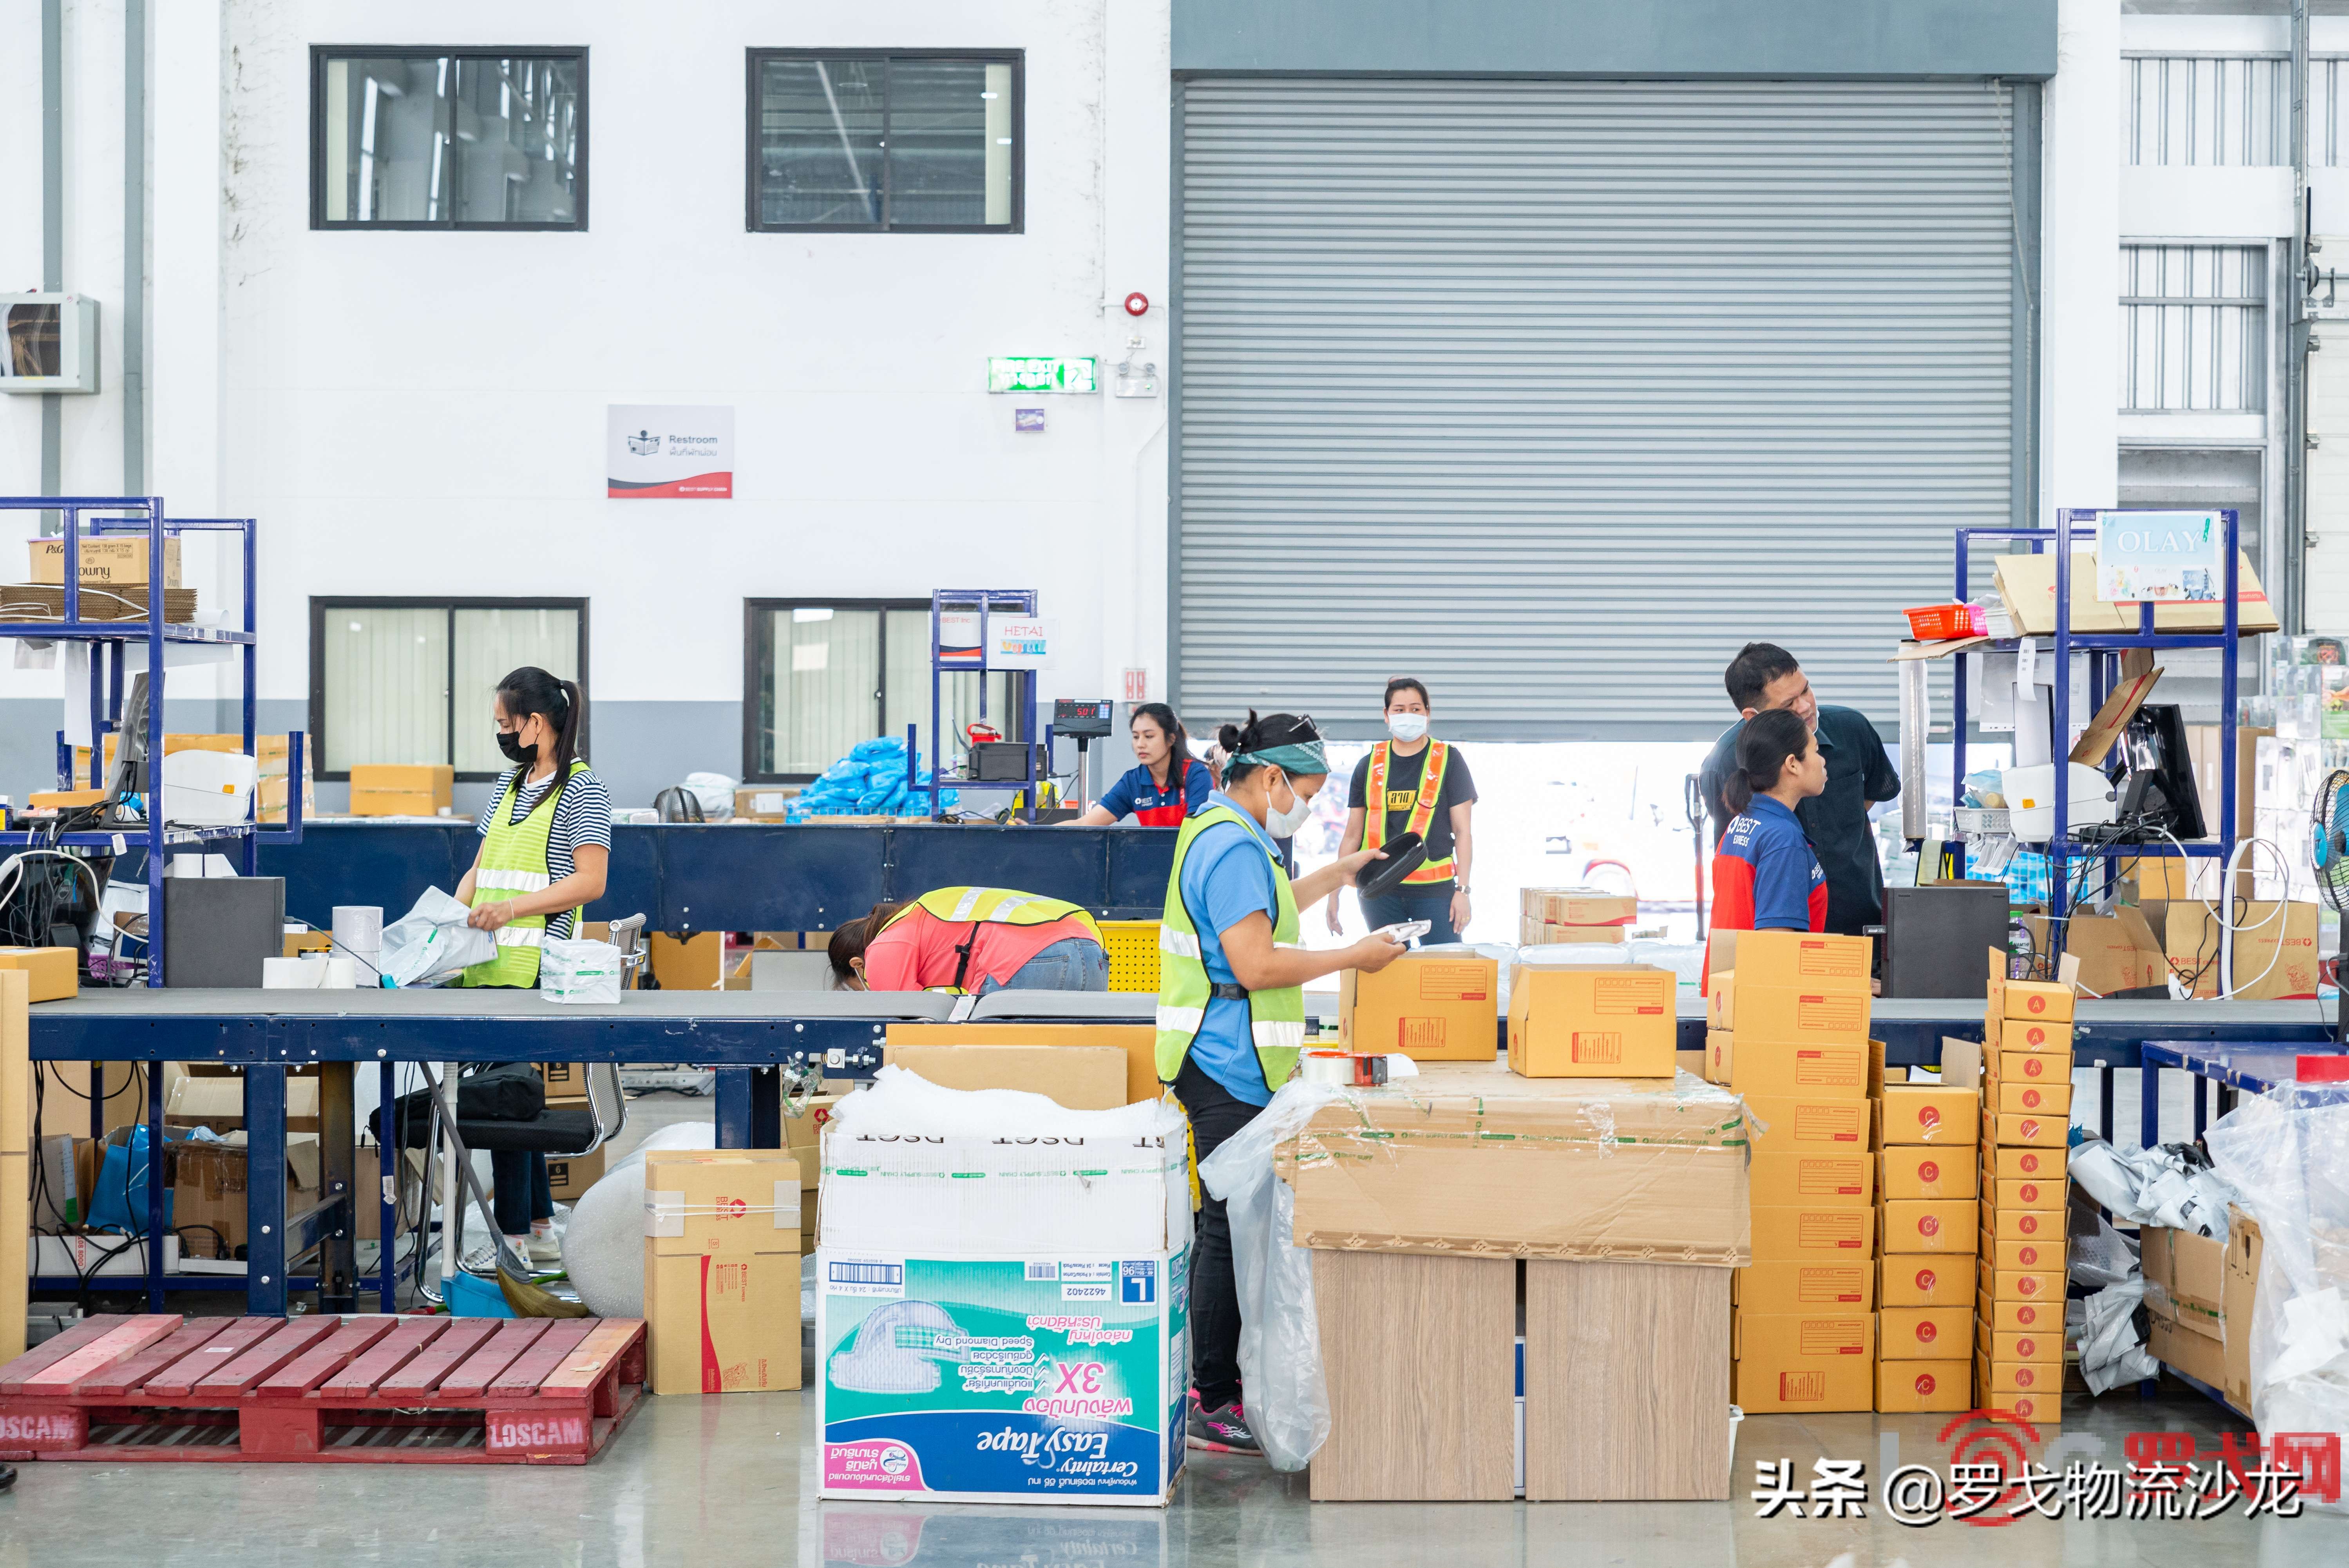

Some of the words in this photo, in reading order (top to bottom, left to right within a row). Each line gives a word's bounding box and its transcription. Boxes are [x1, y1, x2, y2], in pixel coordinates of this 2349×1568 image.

[991, 359, 1025, 373] FIRE
[1027, 359, 1060, 373] EXIT
[998, 373, 1052, 386] ทางออก
[669, 435, 718, 444] Restroom
[670, 446, 717, 457] พื้นที่พักผ่อน
[2117, 530, 2200, 553] OLAY
[45, 544, 64, 554] P&G
[79, 567, 110, 579] owny
[1004, 626, 1043, 637] HETAI
[1736, 817, 1761, 835] BEST
[2032, 1000, 2040, 1010] A
[2031, 1031, 2040, 1042] A
[2029, 1063, 2037, 1073] A
[2027, 1094, 2035, 1104] A
[1925, 1111, 1933, 1122] C
[2025, 1123, 2034, 1134] A
[2025, 1158, 2033, 1168] A
[1924, 1166, 1933, 1177] C
[2025, 1188, 2033, 1199] A
[1924, 1220, 1932, 1232] C
[2024, 1219, 2032, 1230] A
[2024, 1251, 2032, 1261] A
[1123, 1266, 1135, 1275] 96
[1921, 1274, 1930, 1285] C
[1131, 1277, 1146, 1301] L
[2023, 1280, 2030, 1291] A
[1067, 1288, 1106, 1296] 4622402
[2022, 1310, 2030, 1320] A
[1028, 1317, 1101, 1331] ประหยัดกว่า
[1068, 1330, 1131, 1344] กล่องใหญ่
[1922, 1326, 1930, 1338] C
[936, 1335, 952, 1346] Dry
[956, 1338, 998, 1346] Diamond
[1002, 1336, 1033, 1346] Speed
[2022, 1342, 2030, 1353] A
[973, 1350, 1033, 1364] ดูดซึมเร็วด้วย
[1054, 1363, 1104, 1394] 3X
[2021, 1373, 2029, 1383] A
[1921, 1379, 1929, 1390] C
[1024, 1398, 1131, 1418] พลังปกป้อง
[2020, 1403, 2028, 1414] A
[0, 1416, 74, 1439] SCAM
[490, 1420, 583, 1447] LOSCAM
[977, 1426, 1040, 1459] Tape
[1044, 1426, 1108, 1459] Easy
[830, 1448, 879, 1459] รามาธิบดี
[845, 1458, 878, 1471] มูลนิธิ
[1060, 1457, 1138, 1477] Certainty
[1028, 1478, 1041, 1486] เทป
